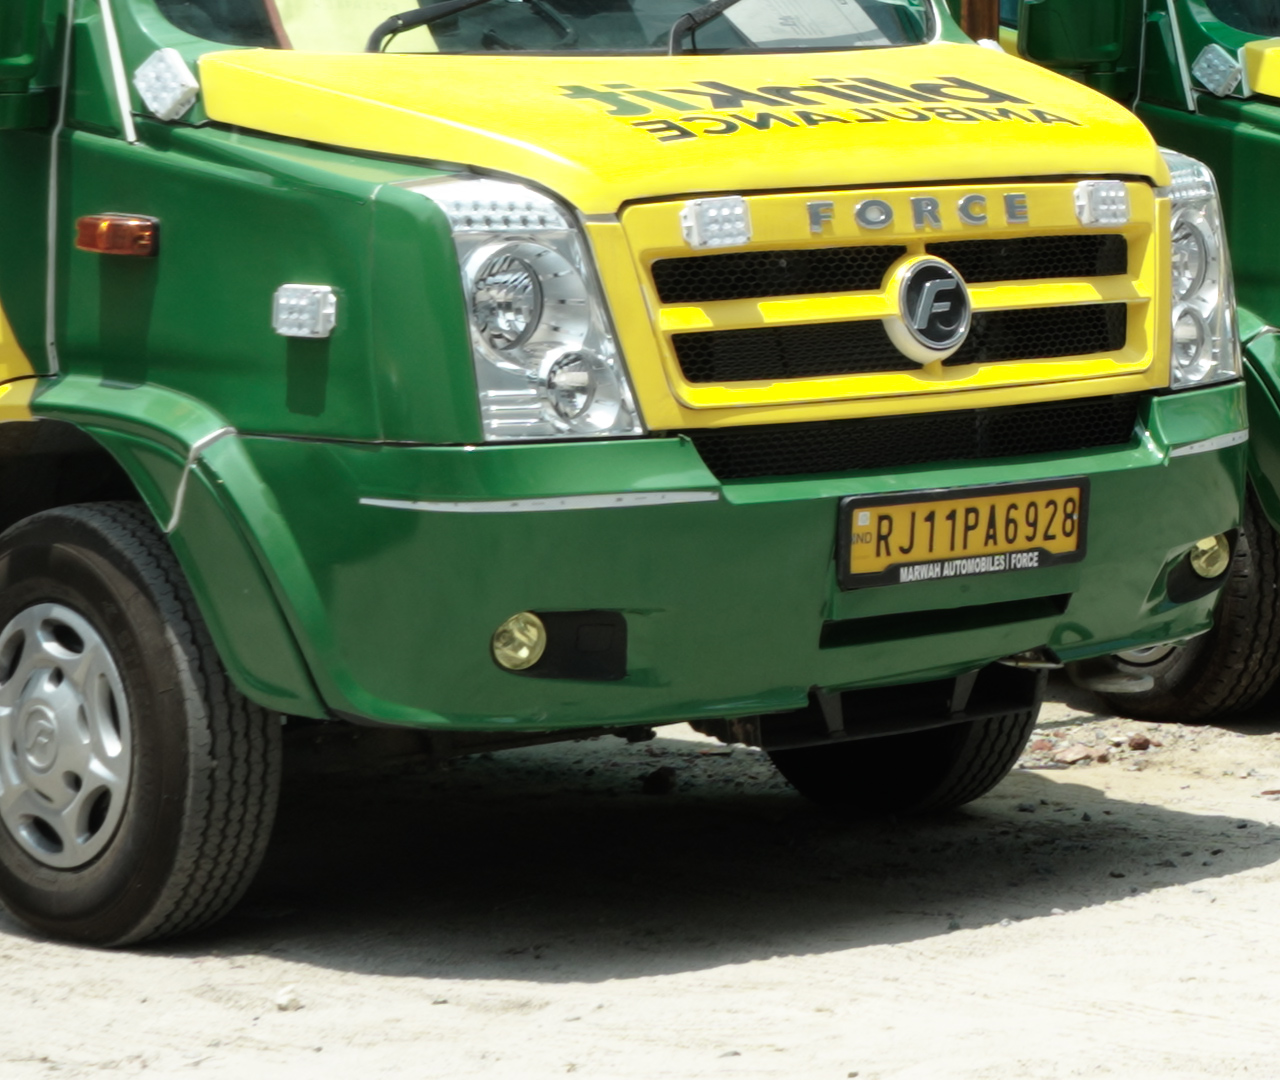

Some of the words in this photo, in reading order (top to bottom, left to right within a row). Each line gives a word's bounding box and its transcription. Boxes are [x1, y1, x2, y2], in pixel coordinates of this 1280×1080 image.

[807, 192, 1030, 234] FORCE
[852, 531, 873, 545] IND
[875, 497, 1077, 558] RJ11PA6928
[900, 562, 941, 583] MARWAH
[942, 555, 1005, 578] AUTOMOBILES
[1011, 551, 1040, 568] FORCE
